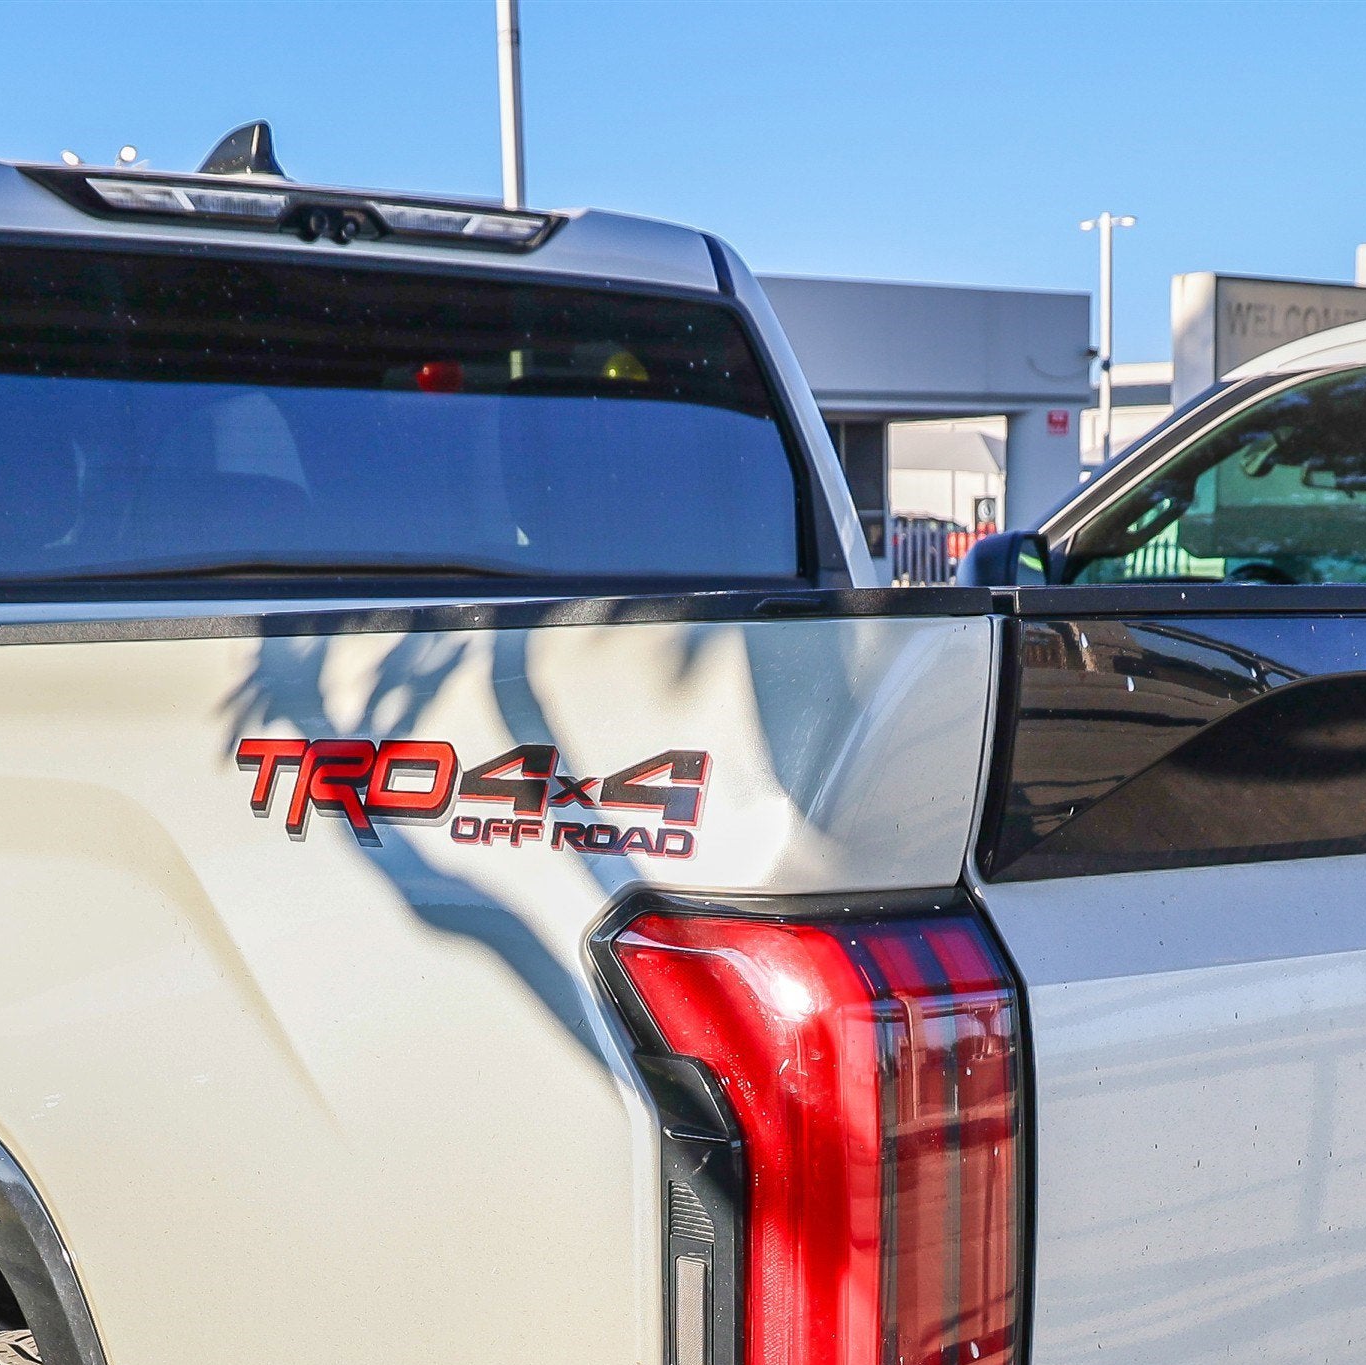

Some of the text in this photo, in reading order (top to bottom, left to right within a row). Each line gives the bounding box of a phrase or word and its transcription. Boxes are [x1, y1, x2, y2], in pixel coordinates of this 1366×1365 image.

[235, 738, 459, 847] TRD
[450, 816, 701, 860] OFF ROAD
